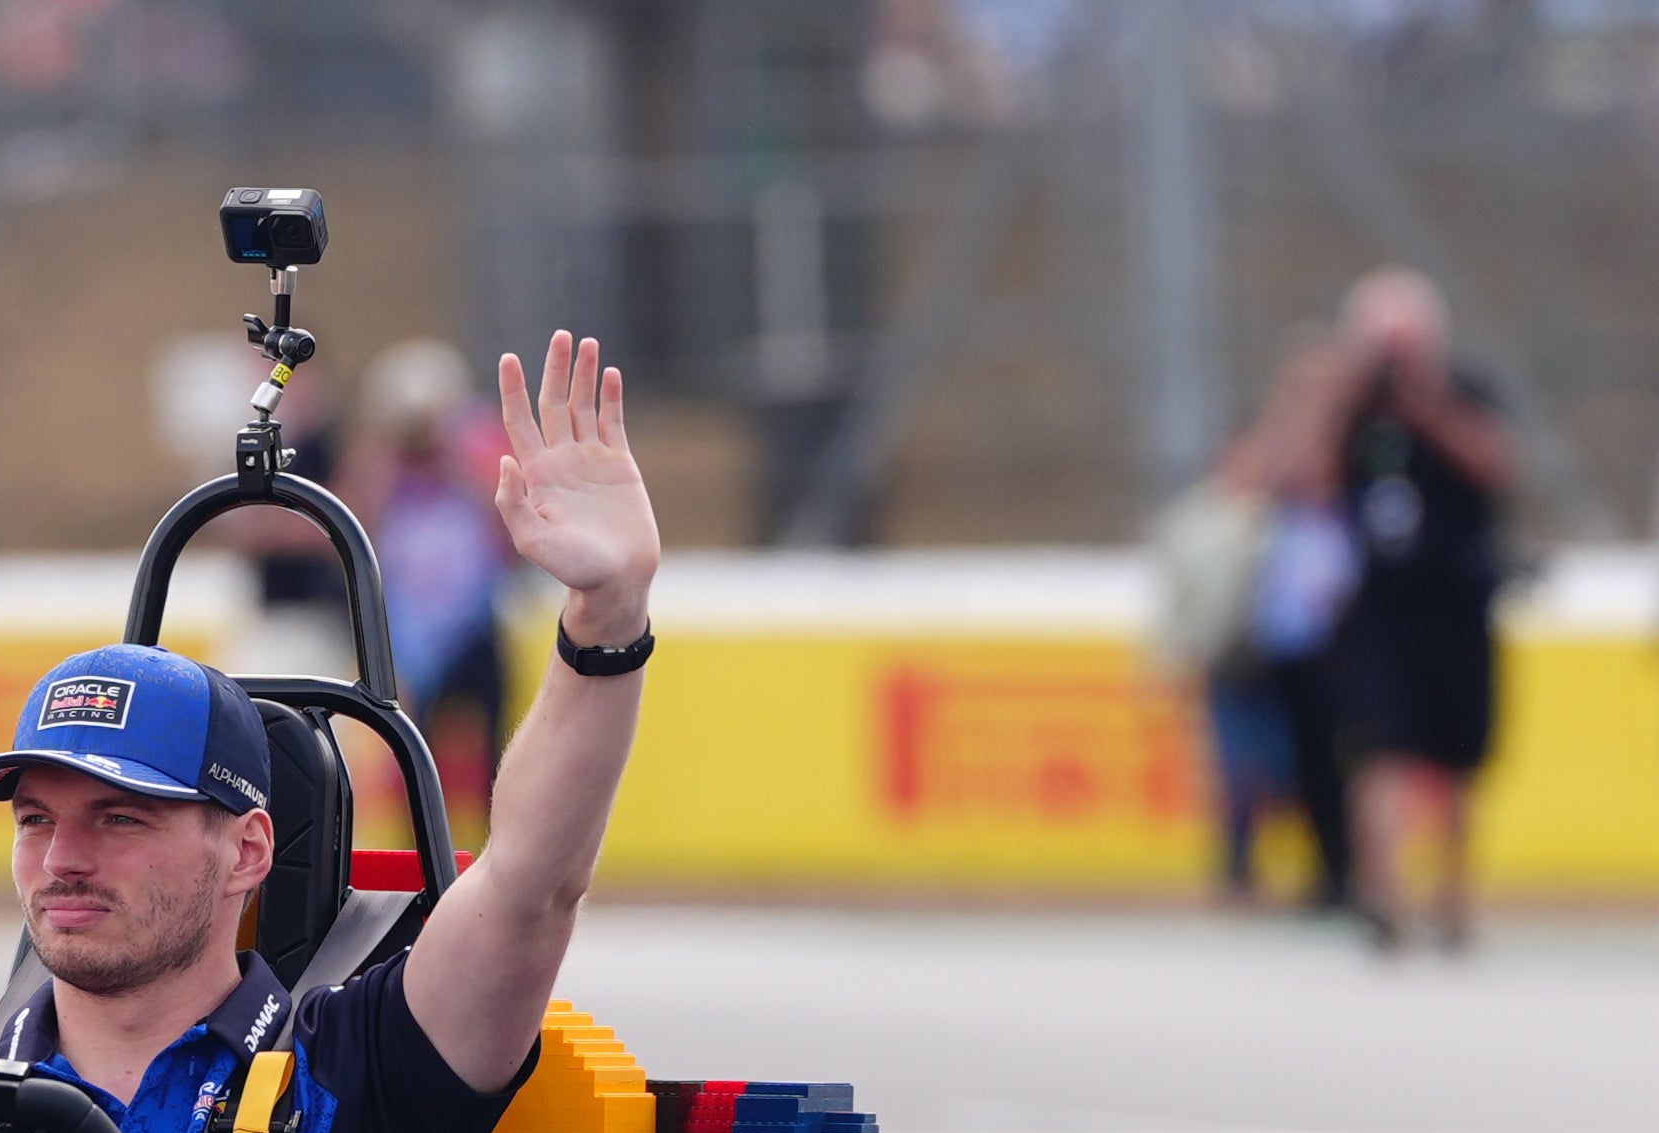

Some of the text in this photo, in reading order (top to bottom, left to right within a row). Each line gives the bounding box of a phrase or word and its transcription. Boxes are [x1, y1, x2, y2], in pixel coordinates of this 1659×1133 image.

[54, 684, 121, 698] ORACLE
[47, 711, 115, 720] RACING
[208, 763, 267, 809] ALPHATAURI
[244, 994, 280, 1053] DAMAC
